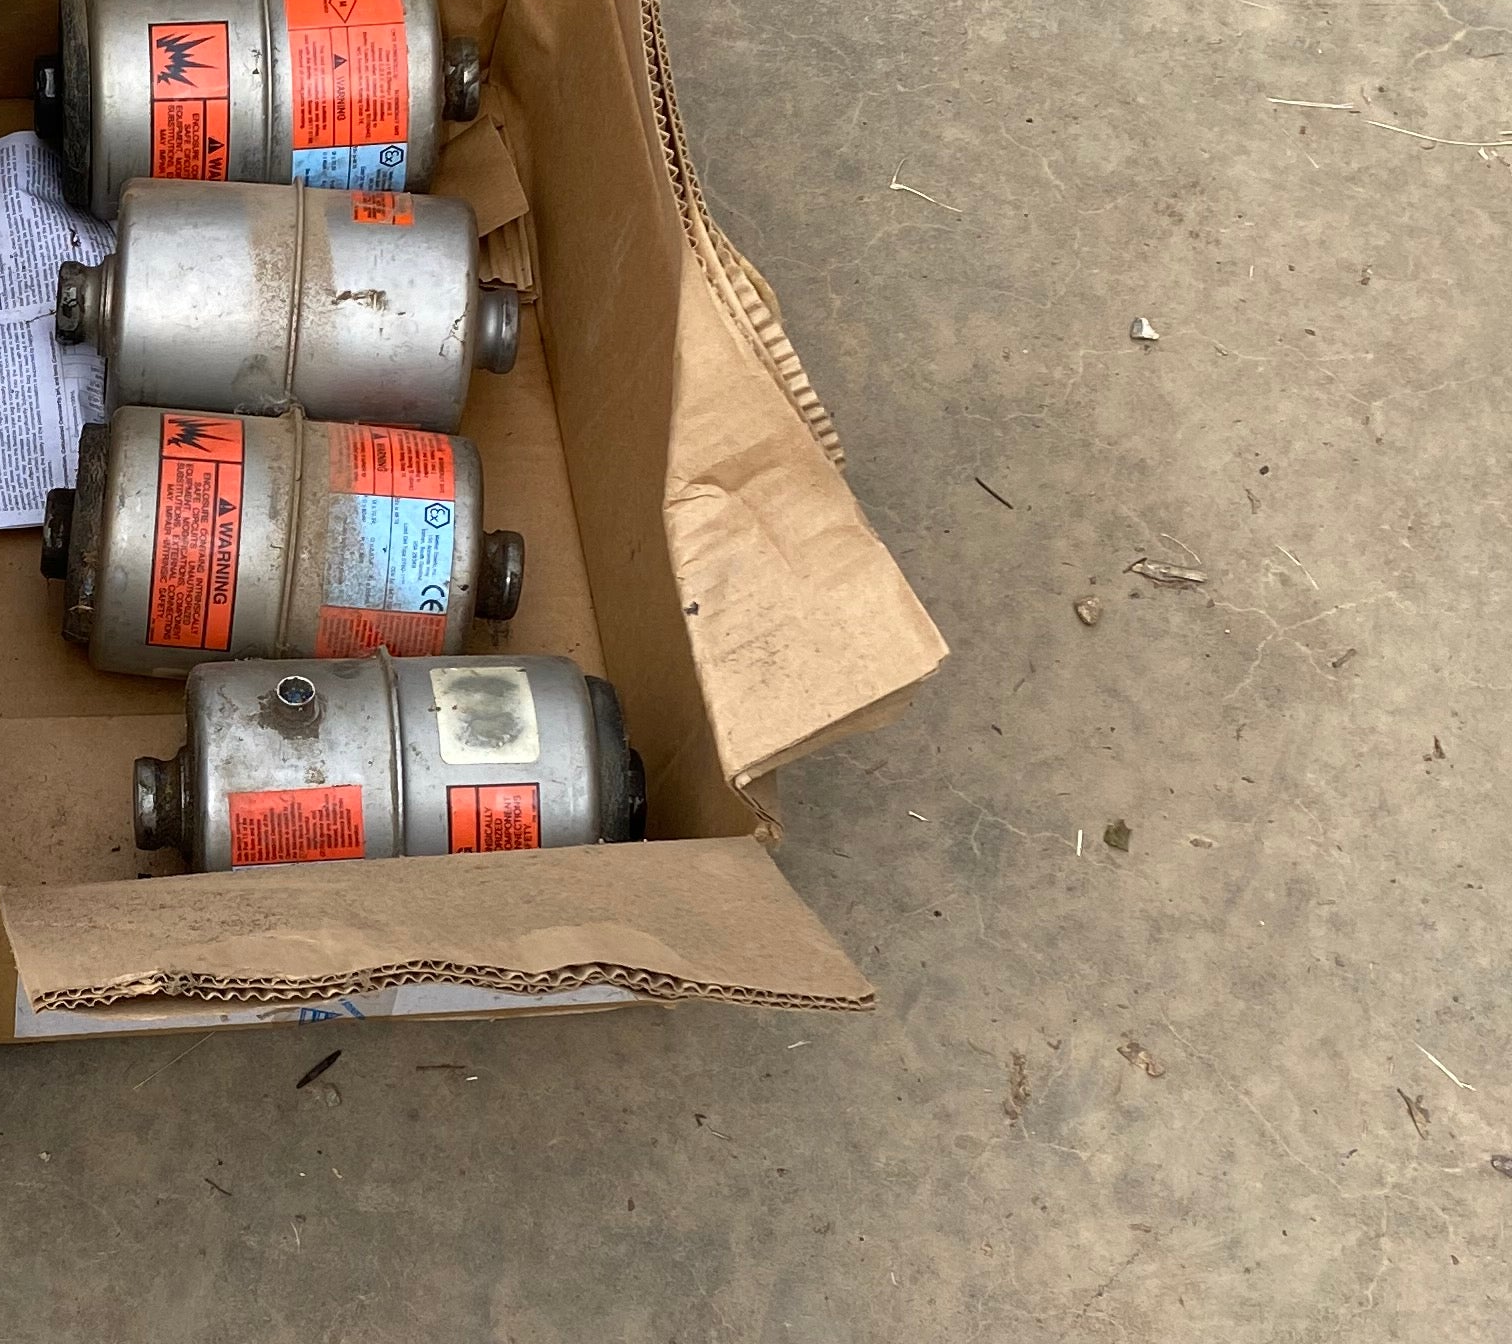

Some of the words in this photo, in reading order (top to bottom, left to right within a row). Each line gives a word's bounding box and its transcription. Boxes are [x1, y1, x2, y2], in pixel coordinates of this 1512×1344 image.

[336, 76, 346, 121] WARNING
[183, 123, 191, 144] SAFE
[191, 113, 199, 160] ENCLOSURE
[158, 149, 166, 173] IMPAIR
[377, 443, 387, 473] WARNING
[165, 483, 174, 501] MAY
[192, 481, 201, 503] SAFE
[199, 472, 211, 523] ENCLOSURE
[163, 505, 173, 535] IMPAIR
[159, 539, 170, 583] INTRINSIC
[168, 533, 179, 581] EXTERNAL
[195, 527, 207, 573] CONTAINS
[212, 521, 233, 605] WARNING
[163, 583, 175, 641] CONNECTIONS
[182, 559, 195, 626] UNAUTHORIZED
[190, 576, 203, 635] INTRINSICALLY
[420, 585, 445, 612] CE
[172, 591, 184, 640] COMPONENT
